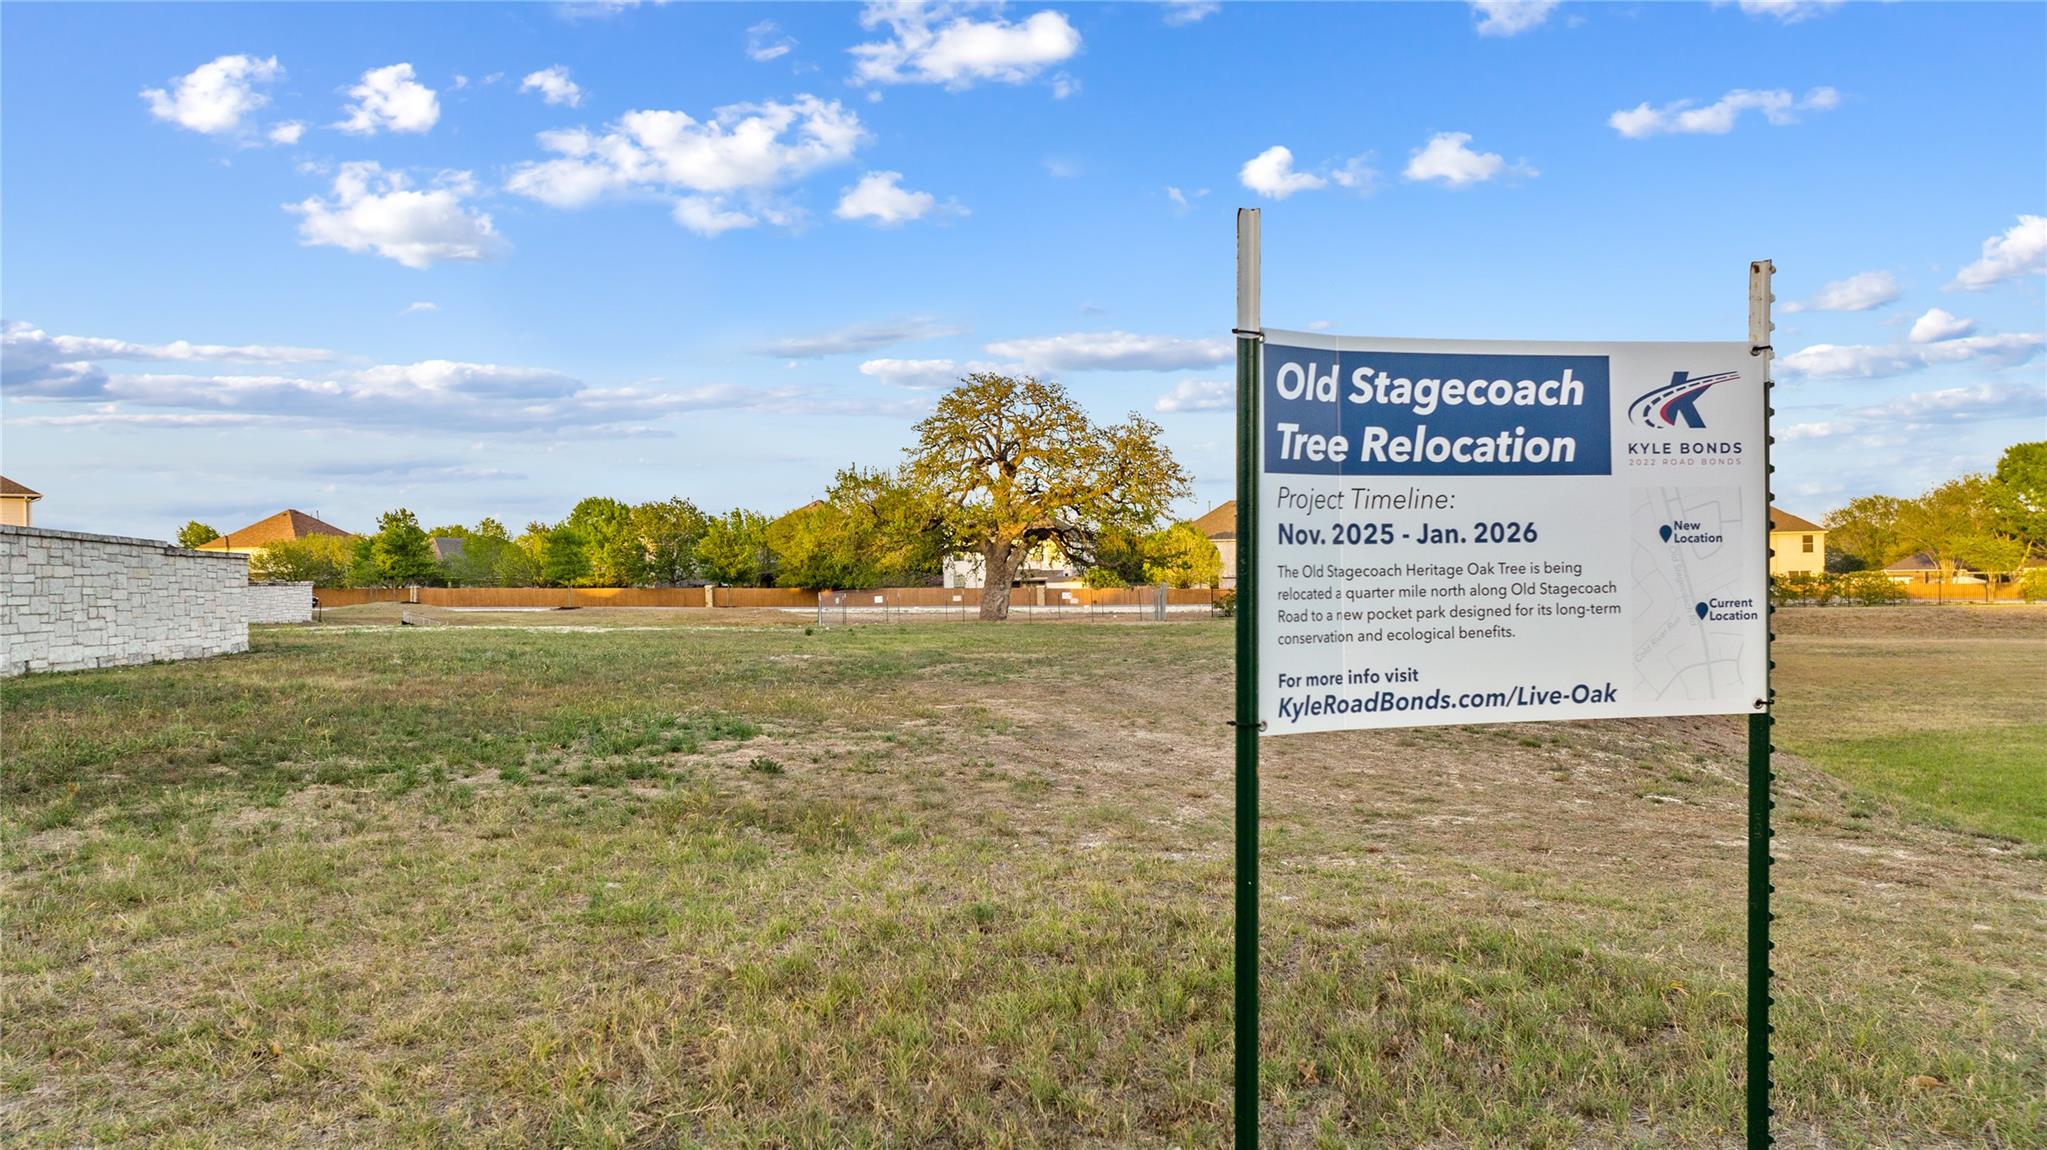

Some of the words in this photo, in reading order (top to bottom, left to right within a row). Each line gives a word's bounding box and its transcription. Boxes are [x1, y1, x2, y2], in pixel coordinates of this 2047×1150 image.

[1276, 362, 1340, 403] Old
[1348, 366, 1585, 416] Stagecoach
[1277, 422, 1349, 462] Tree
[1360, 424, 1576, 464] Relocation
[1628, 442, 1672, 455] KYLE
[1680, 442, 1742, 455] BONDS
[1629, 458, 1656, 467] 2022
[1662, 458, 1695, 467] ROAD
[1701, 457, 1742, 467] BONDS
[1277, 486, 1344, 516] Project
[1351, 487, 1455, 510] Timeline:
[1278, 523, 1326, 545] Nov.
[1332, 523, 1394, 545] 2025
[1416, 523, 1467, 545] Jan.
[1474, 522, 1538, 544] 2026
[1674, 520, 1701, 531] New
[1674, 533, 1723, 544] Location
[1277, 565, 1299, 578] The
[1302, 564, 1324, 578] Old
[1327, 563, 1402, 581] Stagecoach
[1406, 563, 1463, 579] Heritage
[1467, 562, 1495, 576] Oak
[1498, 562, 1526, 574] Tree
[1530, 561, 1540, 574] is
[1544, 560, 1582, 577] being
[1277, 586, 1332, 601] relocated
[1335, 589, 1342, 599] a
[1345, 587, 1395, 602] quarter
[1399, 584, 1427, 598] mile
[1431, 583, 1466, 597] north
[1469, 582, 1507, 599] along
[1511, 581, 1536, 596] Old
[1539, 580, 1617, 598] Stagecoach
[1278, 608, 1308, 623] Road
[1311, 610, 1323, 622] to
[1326, 612, 1333, 621] a
[1367, 606, 1412, 623] pocket
[1416, 604, 1446, 621] park
[1449, 603, 1511, 621] designed
[1515, 602, 1535, 617] for
[1537, 602, 1552, 616] its
[1556, 602, 1621, 618] long-term
[1709, 598, 1753, 608] Current
[1709, 610, 1758, 621] Location
[1277, 630, 1354, 645] conservation
[1357, 628, 1383, 642] and
[1386, 626, 1455, 643] ecological
[1459, 624, 1516, 639] benefits.
[1278, 673, 1302, 688] For
[1305, 674, 1343, 687] more
[1348, 668, 1380, 684] info
[1384, 667, 1419, 683] visit
[1278, 682, 1618, 724] KyleRoadBonds.com/Live-Oak
